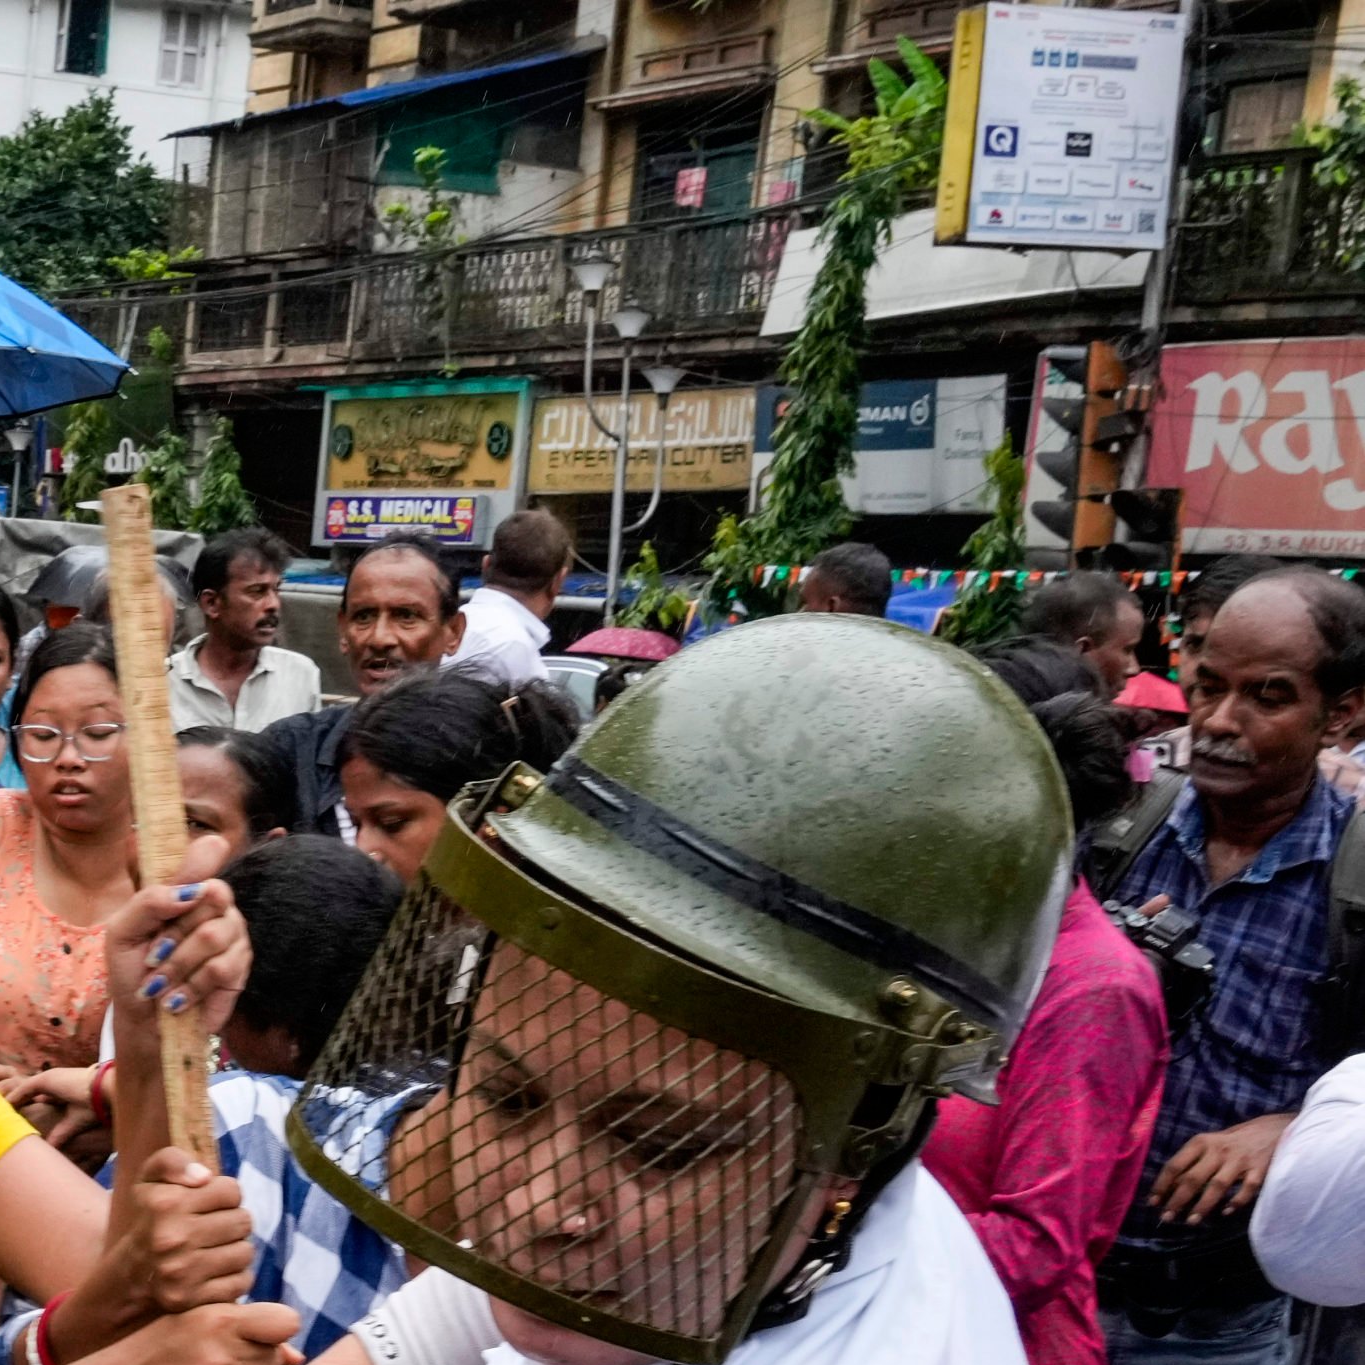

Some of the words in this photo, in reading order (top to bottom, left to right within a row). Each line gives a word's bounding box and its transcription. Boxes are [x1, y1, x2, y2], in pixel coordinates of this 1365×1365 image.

[672, 443, 746, 466] CUTTER
[347, 500, 376, 524] S.S.
[379, 499, 453, 524] MEDICAL
